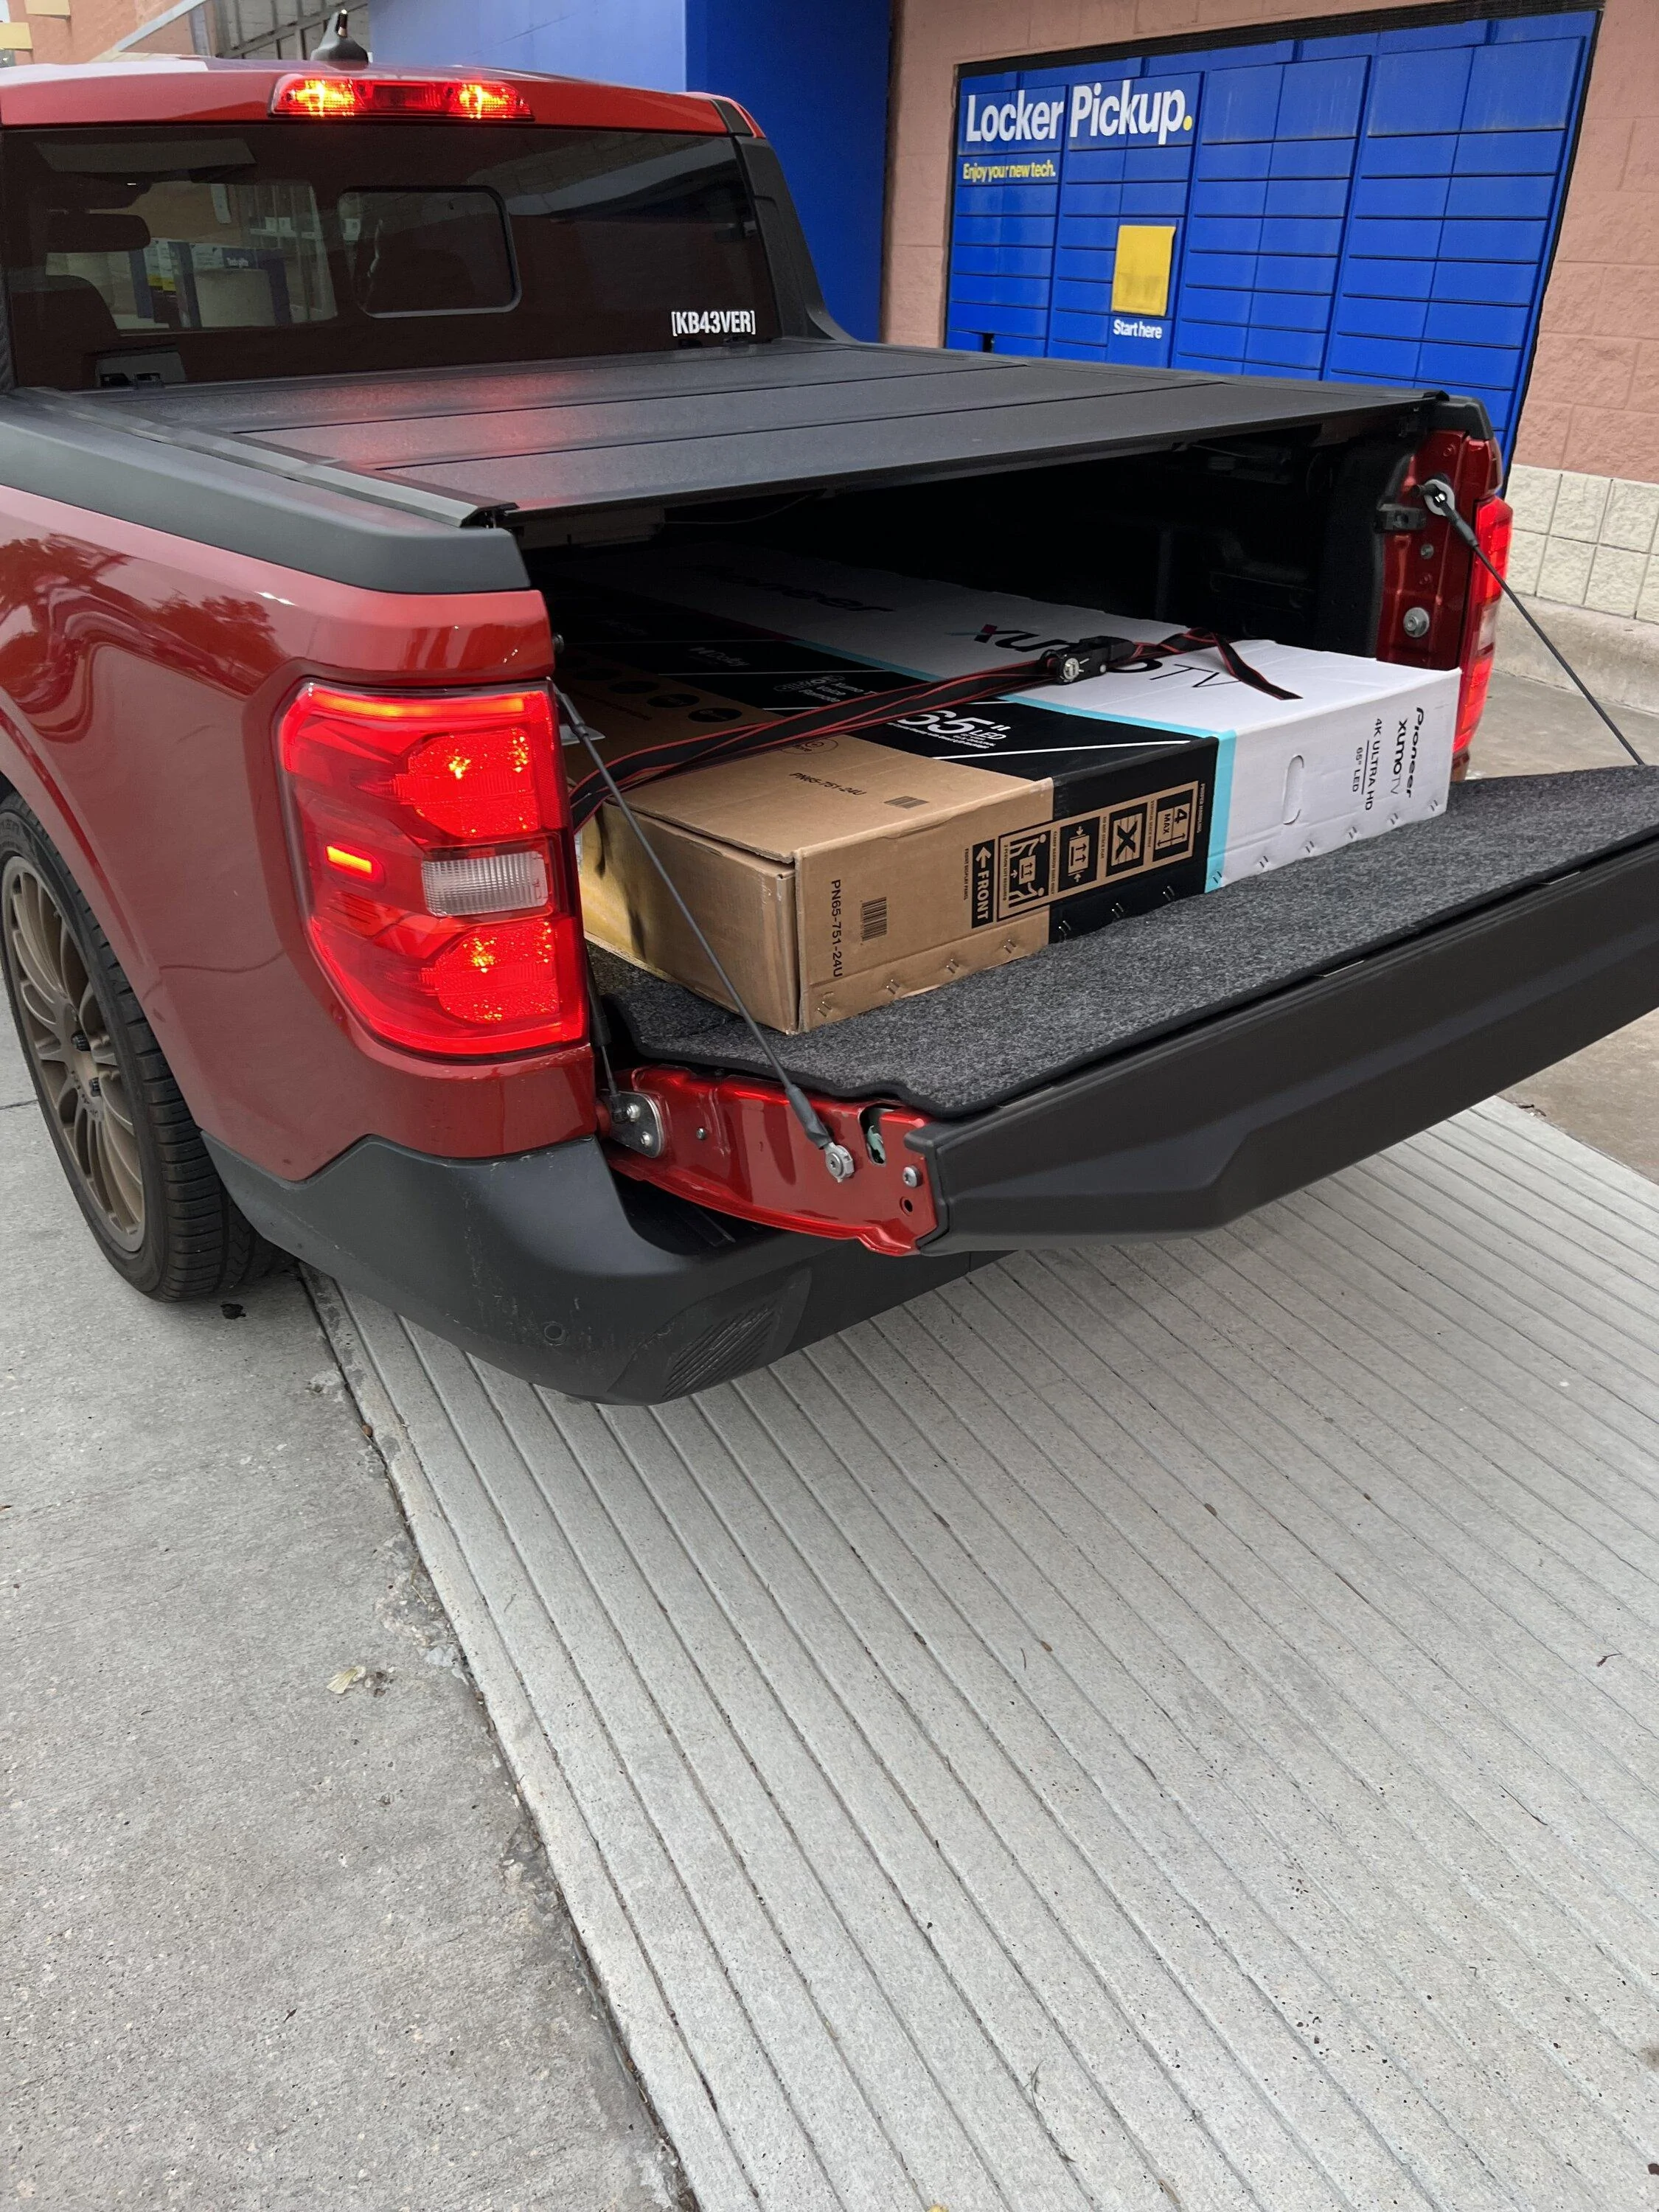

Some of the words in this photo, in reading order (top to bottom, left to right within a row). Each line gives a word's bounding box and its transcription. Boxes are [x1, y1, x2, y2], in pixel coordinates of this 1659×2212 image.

[966, 89, 1064, 142] Locker
[1069, 80, 1193, 145] Pickup.
[963, 162, 987, 183] Enjoy
[987, 166, 1009, 183] your
[1009, 165, 1031, 178] new
[1030, 159, 1056, 177] tech.
[671, 310, 756, 337] [KB43VER]
[1113, 319, 1138, 336] Start
[1138, 321, 1163, 339] here
[969, 729, 1007, 740] LED
[1373, 718, 1383, 737] 4K
[1355, 746, 1363, 765] 65"
[1367, 740, 1381, 787] ULTRA
[1390, 718, 1408, 795] xumoTV
[1405, 706, 1425, 799] Pioneer
[1352, 769, 1361, 793] LED
[1364, 790, 1375, 811] HD
[1162, 813, 1171, 835] MAX
[1174, 808, 1188, 824] 4
[975, 870, 990, 919] FRONT
[831, 879, 843, 978] PN65-751-24U
